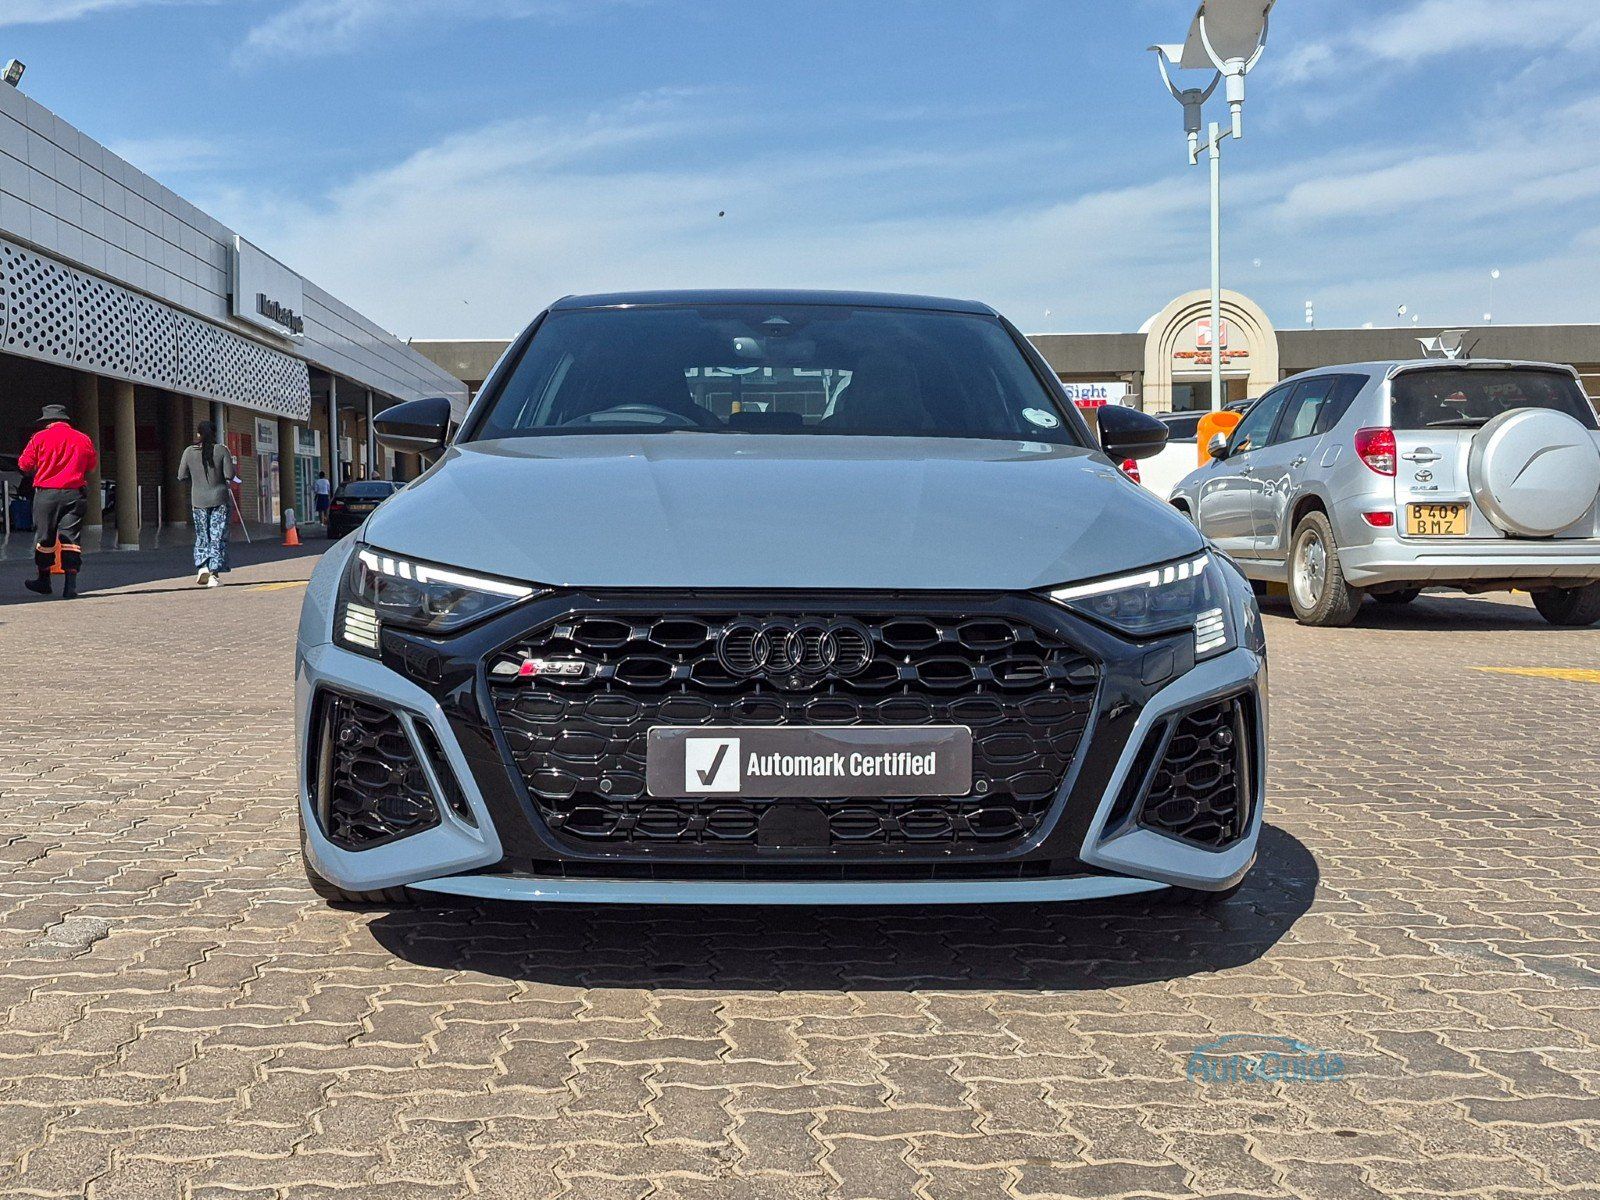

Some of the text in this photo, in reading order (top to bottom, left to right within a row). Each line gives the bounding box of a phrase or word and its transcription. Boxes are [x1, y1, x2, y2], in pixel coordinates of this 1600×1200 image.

[1066, 384, 1107, 400] Sight
[1413, 505, 1459, 519] B 409
[1417, 521, 1453, 534] BMZ
[747, 751, 936, 776] Automark Certified
